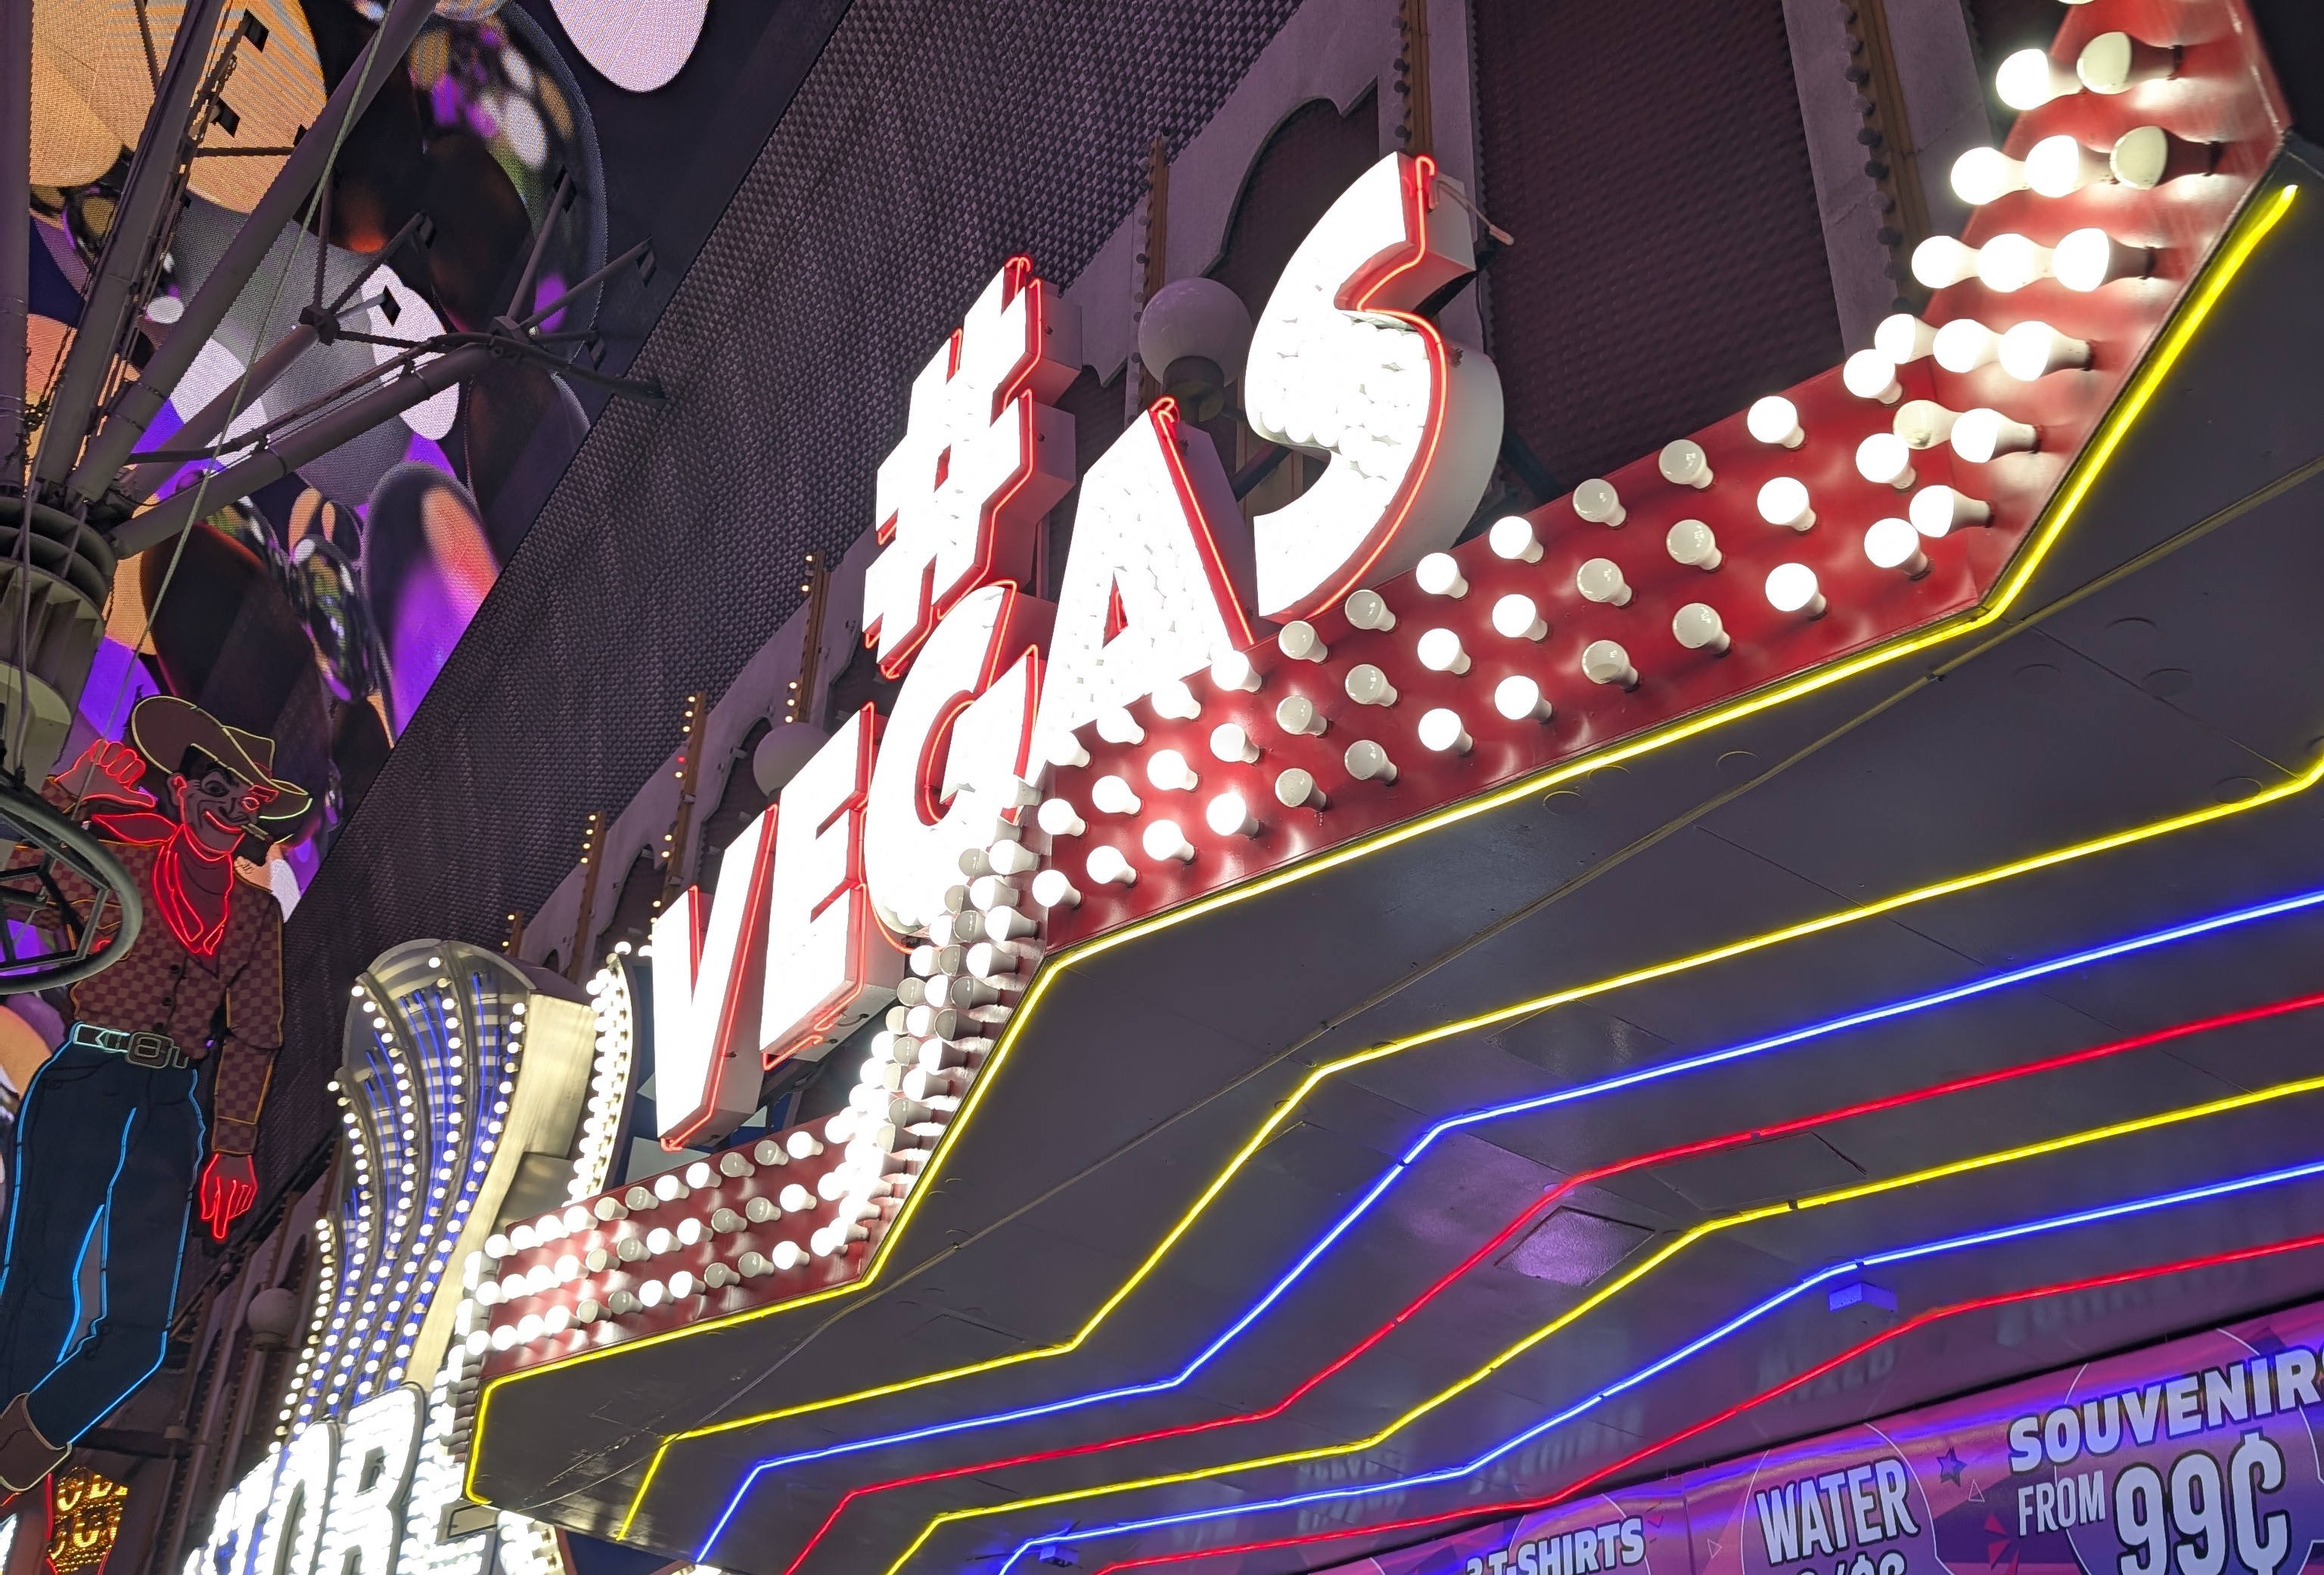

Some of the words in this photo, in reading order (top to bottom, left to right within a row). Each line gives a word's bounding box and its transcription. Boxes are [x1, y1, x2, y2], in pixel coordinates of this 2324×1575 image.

[864, 257, 1061, 679] #
[651, 151, 1479, 1151] VEGAS
[2008, 1347, 2324, 1474] SOUVENIR
[1754, 1457, 1920, 1566] WATER
[2018, 1468, 2106, 1538] FROM
